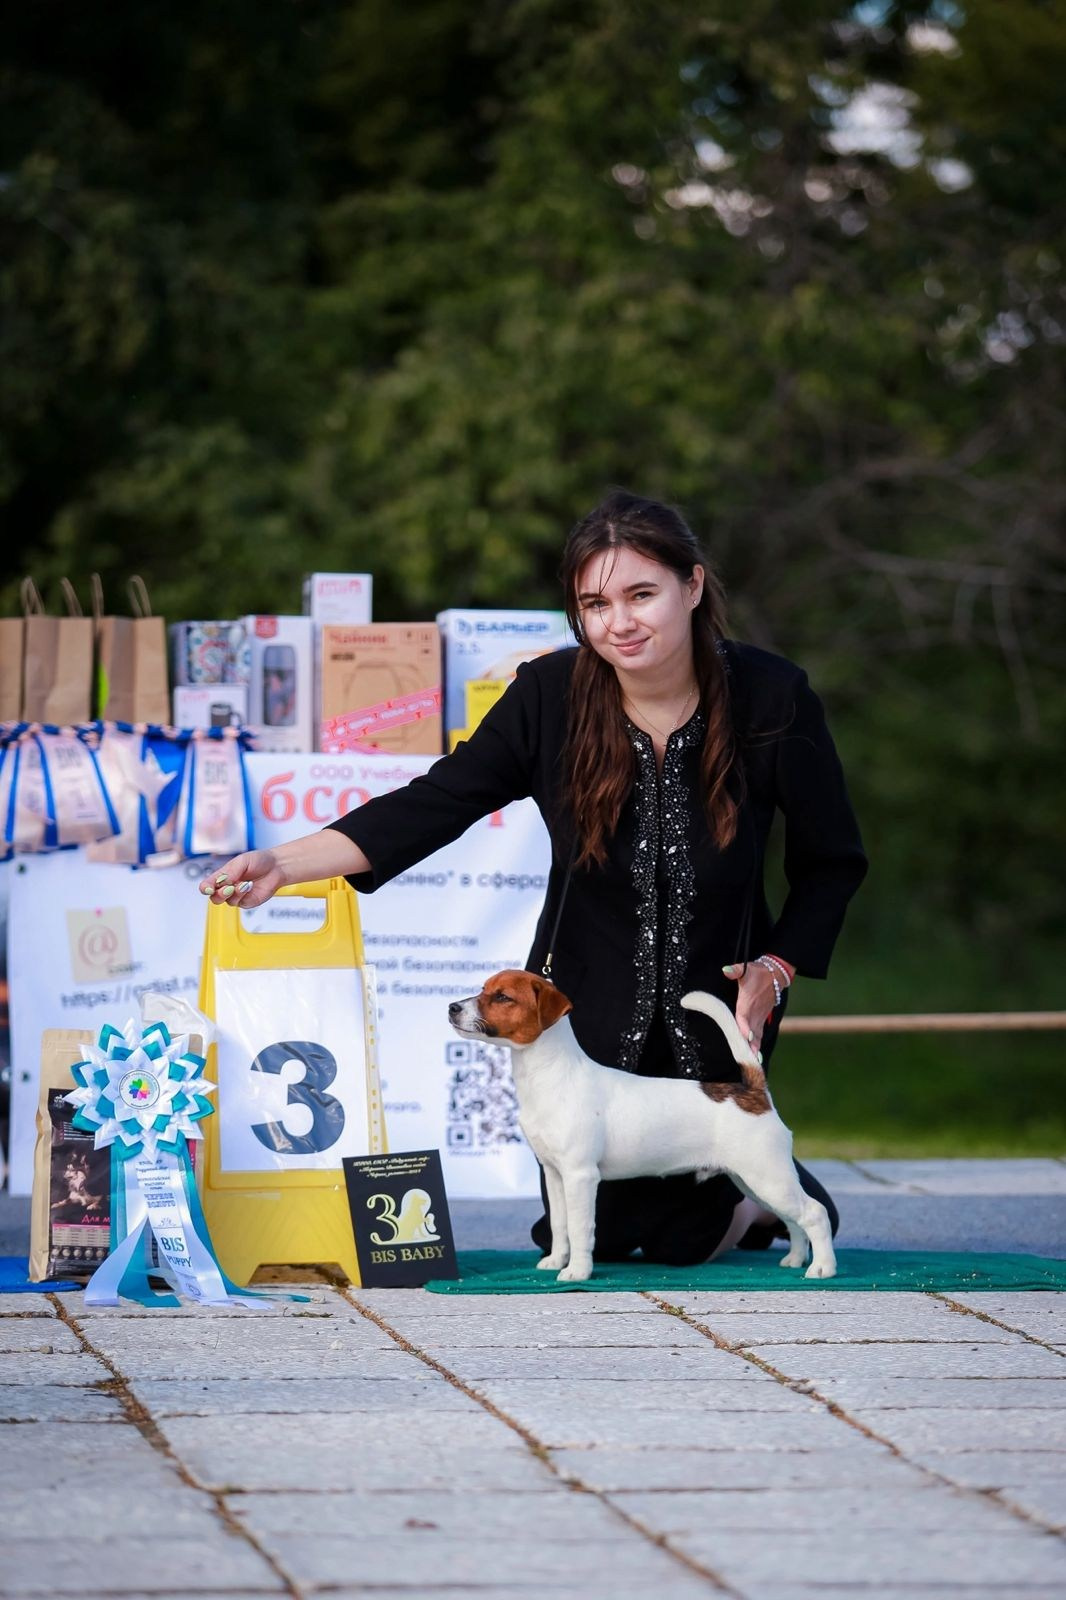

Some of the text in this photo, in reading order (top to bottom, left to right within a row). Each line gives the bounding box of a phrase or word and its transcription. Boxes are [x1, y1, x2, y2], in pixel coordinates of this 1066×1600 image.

[359, 766, 424, 781] Учебн
[477, 870, 547, 890] сфера
[250, 1040, 345, 1154] 3
[366, 1193, 400, 1245] 3
[161, 1237, 184, 1252] BIS
[166, 1255, 191, 1267] PUPPY
[370, 1245, 445, 1264] BIS BABY
